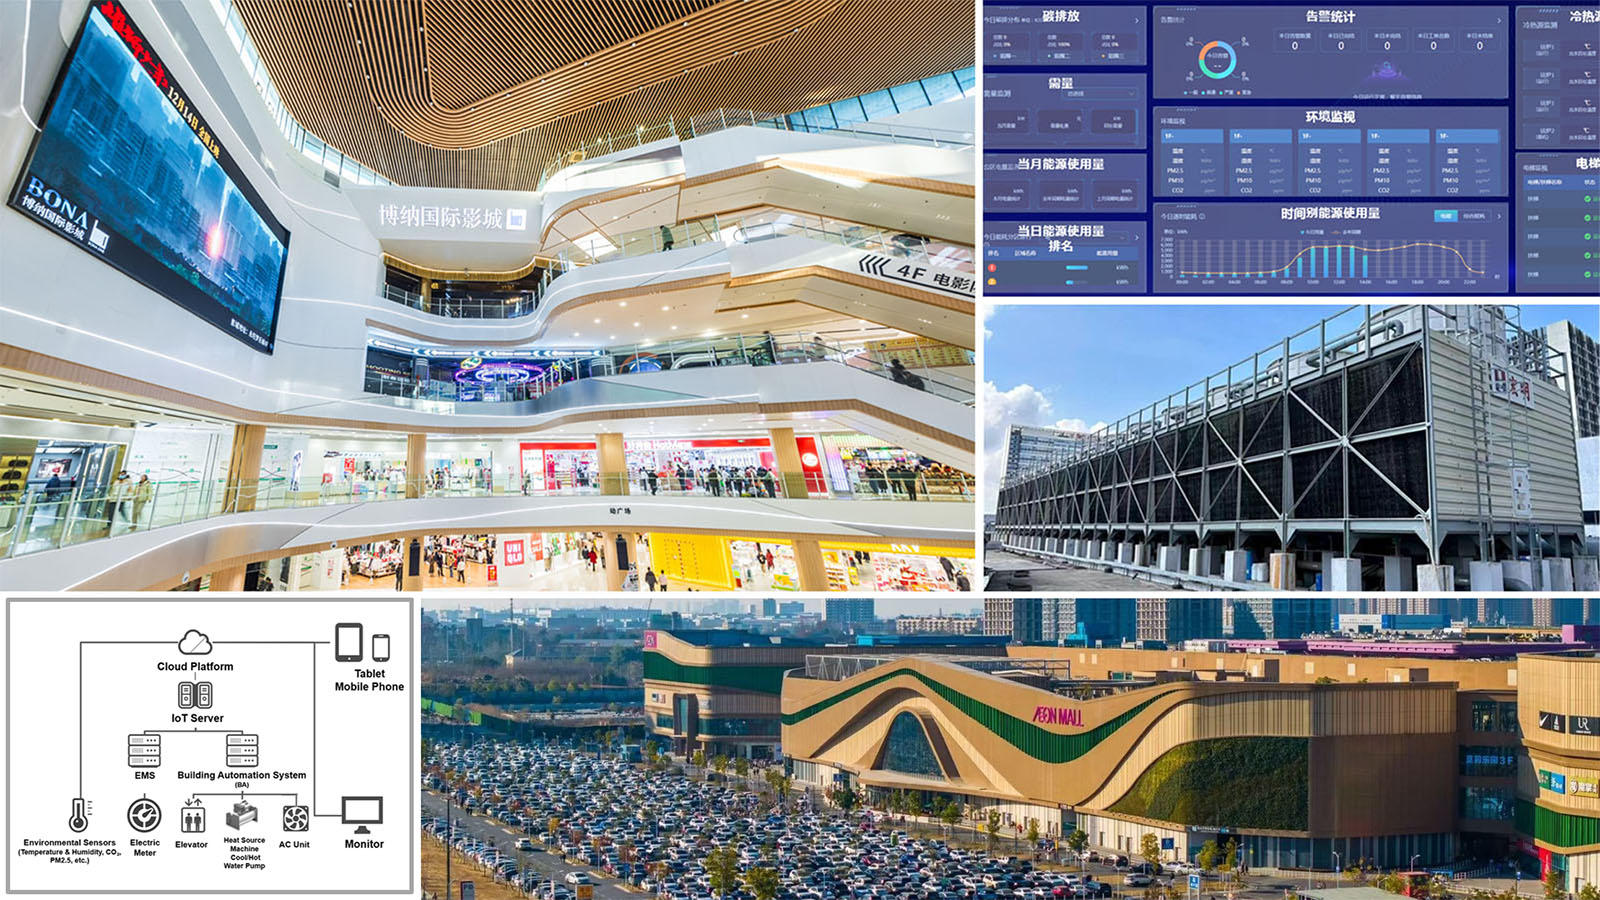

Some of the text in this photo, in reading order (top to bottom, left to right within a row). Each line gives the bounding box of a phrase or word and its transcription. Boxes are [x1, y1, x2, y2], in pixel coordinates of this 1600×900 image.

[1291, 41, 1298, 50] 0
[1338, 41, 1344, 50] 0
[1384, 41, 1391, 50] 0
[1430, 41, 1437, 50] 0
[1476, 41, 1483, 50] 0
[25, 175, 90, 230] BONA
[21, 195, 86, 242] 博纳国际影城
[378, 204, 503, 229] 博纳国际影城
[897, 265, 927, 279] 4F
[506, 543, 521, 554] UNI
[157, 662, 234, 672] Cloud Platform
[354, 669, 385, 679] Tablet
[335, 682, 404, 692] Mobile Phone
[171, 713, 224, 723] IoT Server
[1058, 708, 1084, 727] MALL
[135, 771, 156, 780] EMS
[177, 770, 306, 781] Building Automation System
[234, 781, 249, 789] (BA)
[23, 839, 116, 847] Environmental Sensors
[130, 838, 160, 847] Electric
[175, 841, 208, 849] Elevator
[279, 840, 310, 849] AC Unit
[344, 839, 384, 849] Monitor
[18, 849, 64, 857] (Temperature
[73, 849, 103, 858] Humidity,
[133, 849, 156, 857] Meter
[230, 845, 259, 853] Machine
[50, 857, 90, 865] PM2.5, etc.)
[246, 862, 265, 871] Pump
